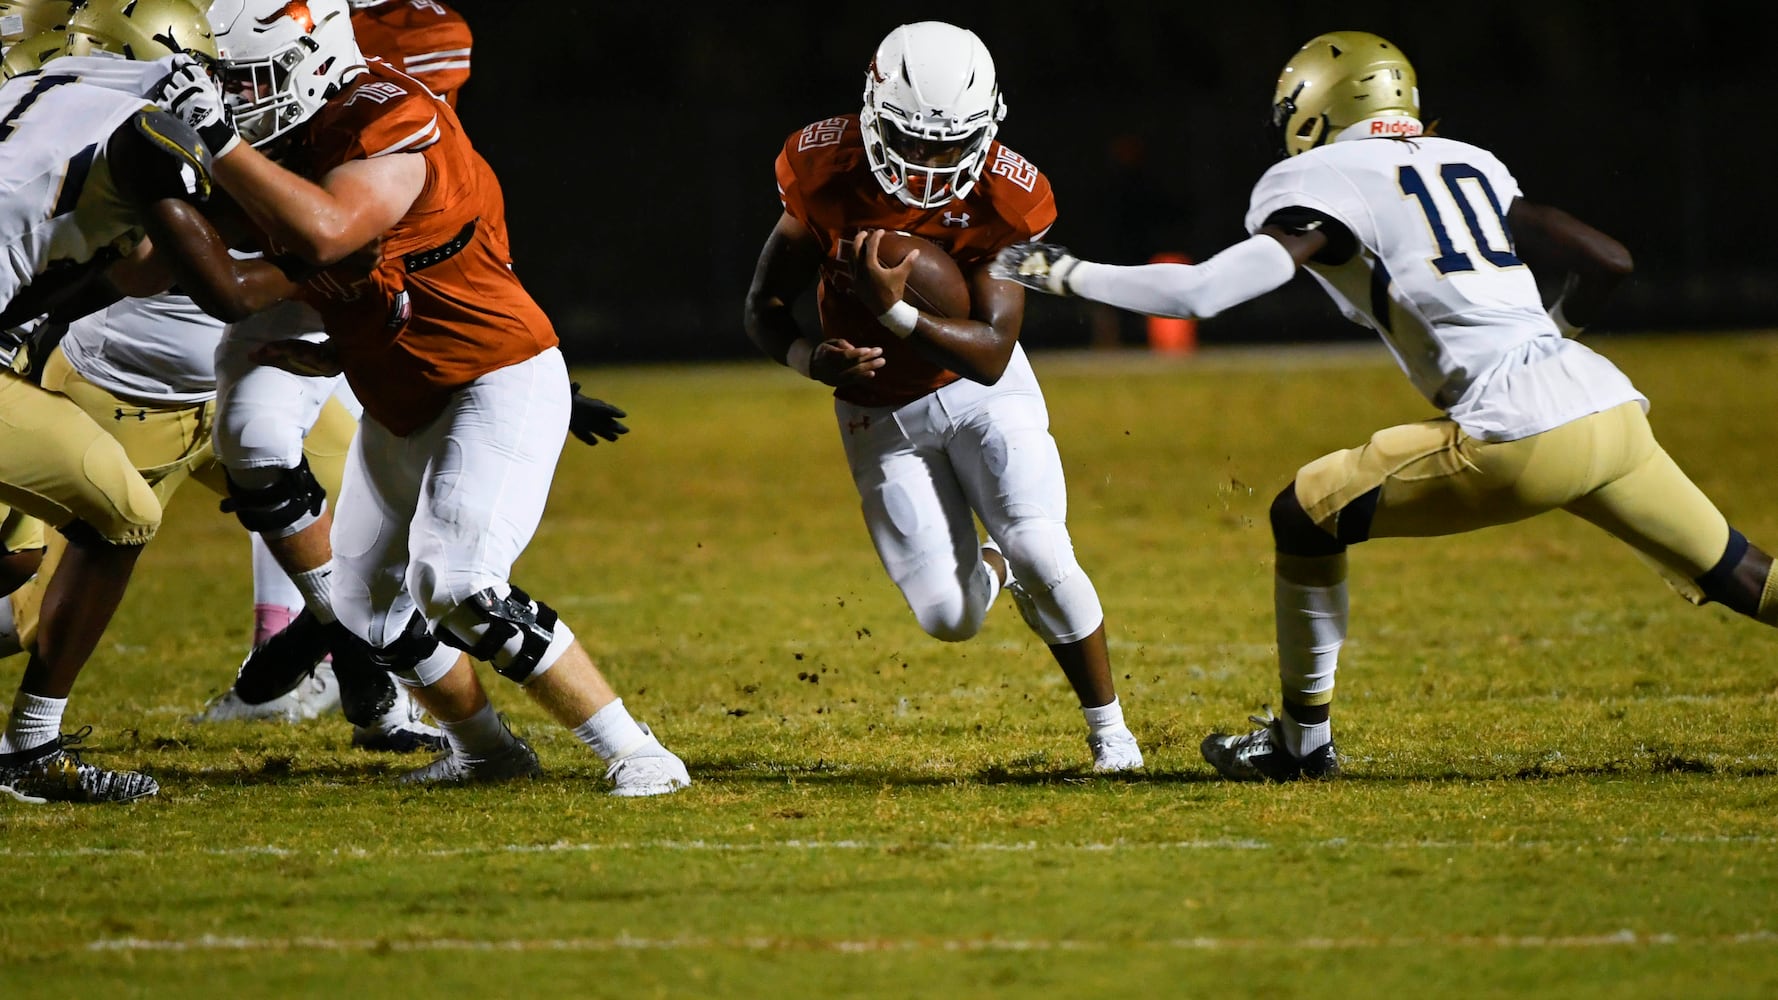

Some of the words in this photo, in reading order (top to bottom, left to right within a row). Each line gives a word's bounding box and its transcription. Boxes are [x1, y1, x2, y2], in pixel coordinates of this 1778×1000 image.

[797, 117, 849, 152] 29
[990, 144, 1038, 193] 29
[1394, 162, 1527, 280] 10
